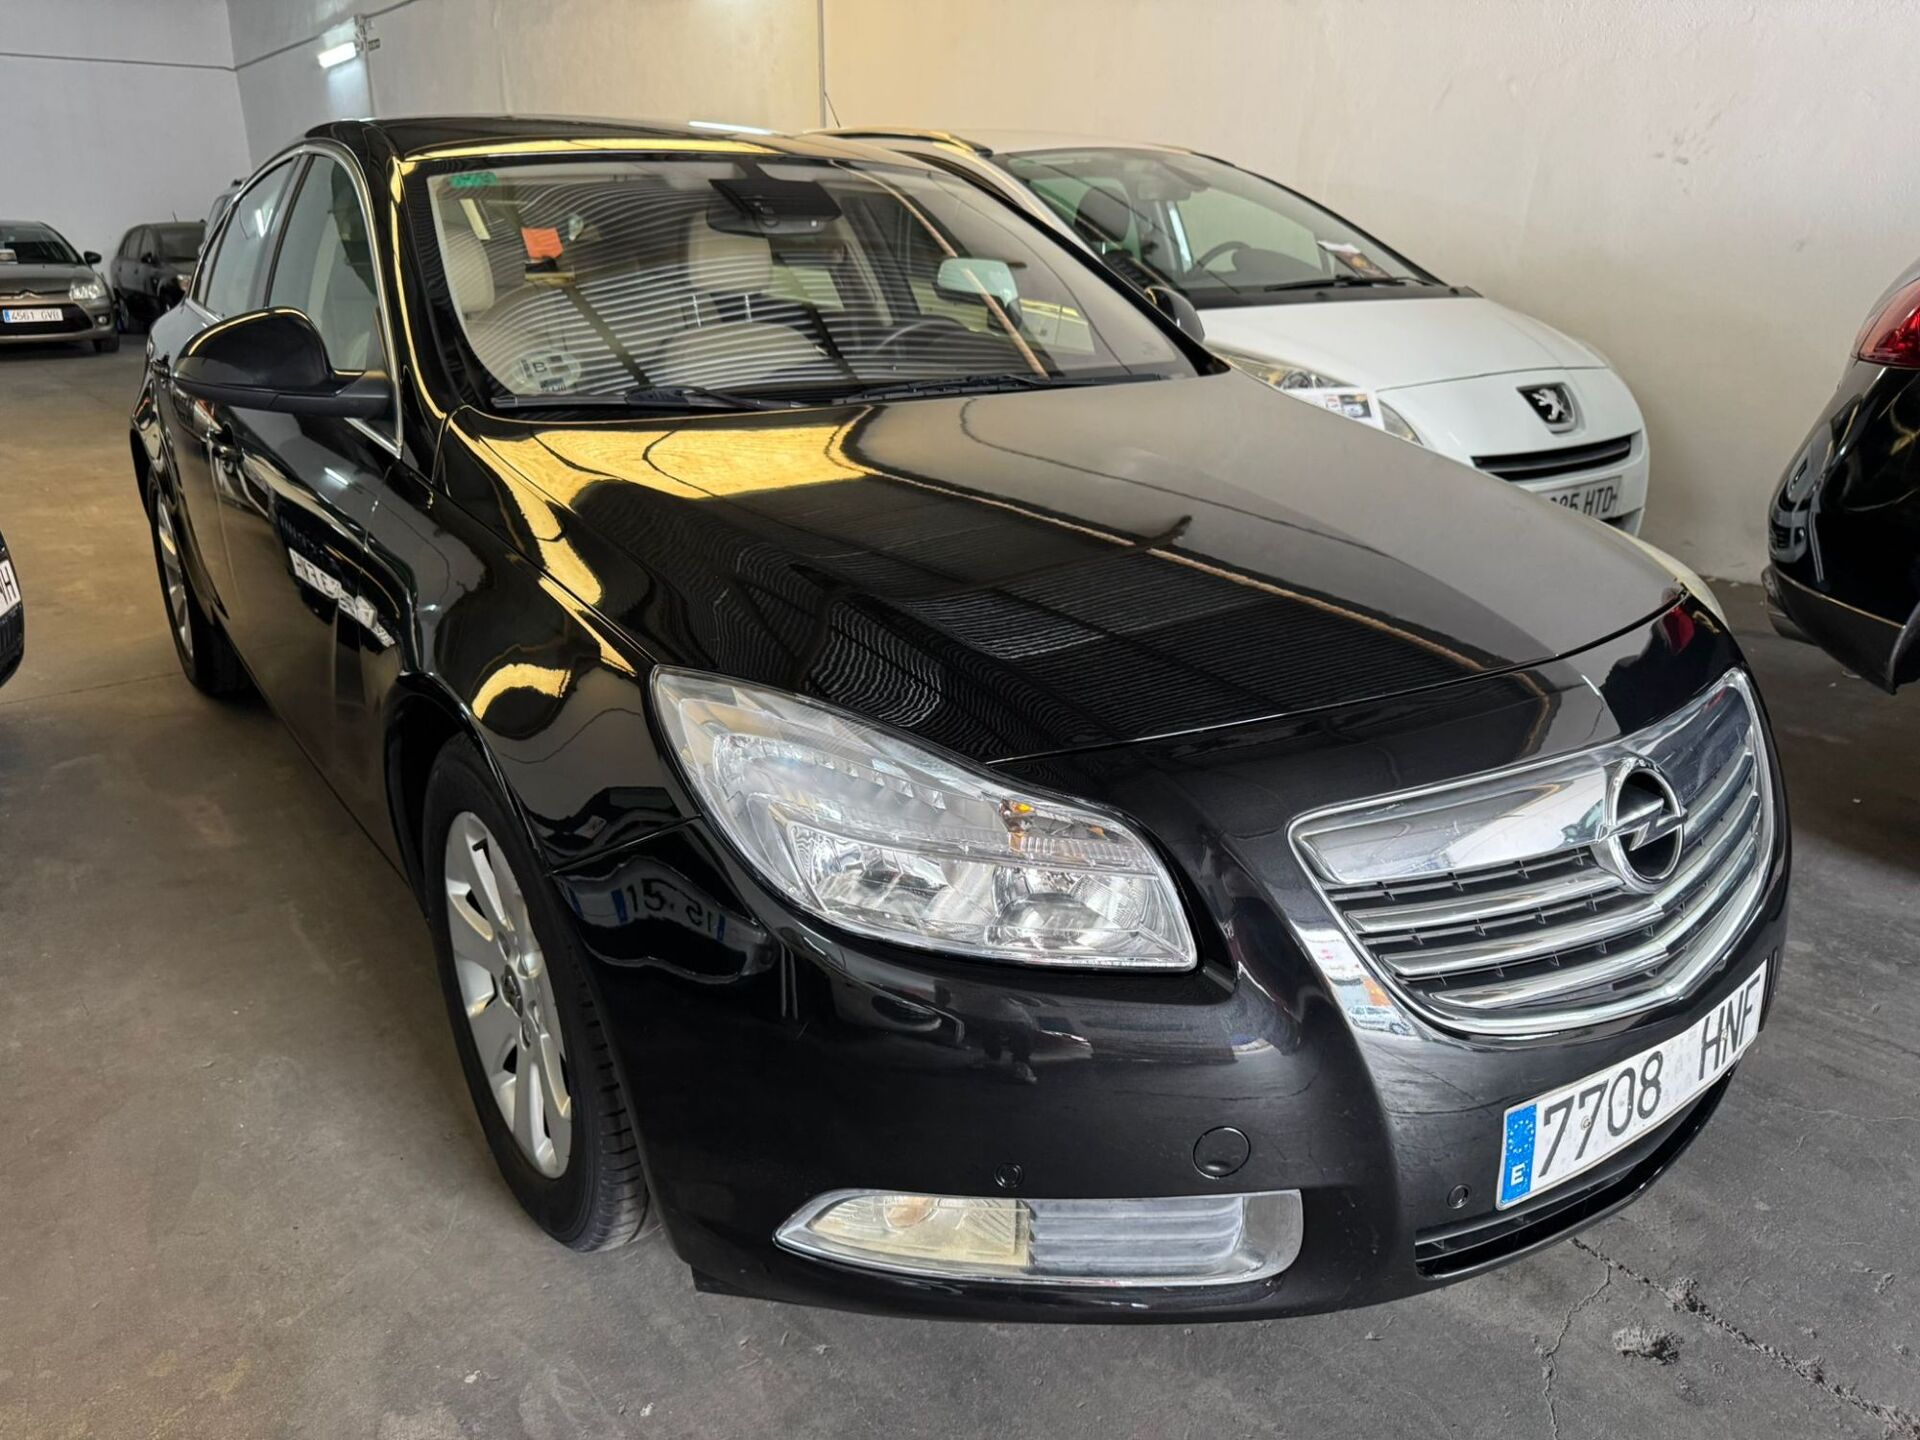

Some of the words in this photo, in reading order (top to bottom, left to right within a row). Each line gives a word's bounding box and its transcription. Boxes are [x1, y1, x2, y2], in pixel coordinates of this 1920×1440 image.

[1583, 486, 1614, 516] HTD
[1538, 1050, 1663, 1178] 7708
[1698, 973, 1761, 1082] HNF
[1510, 1163, 1525, 1185] E
